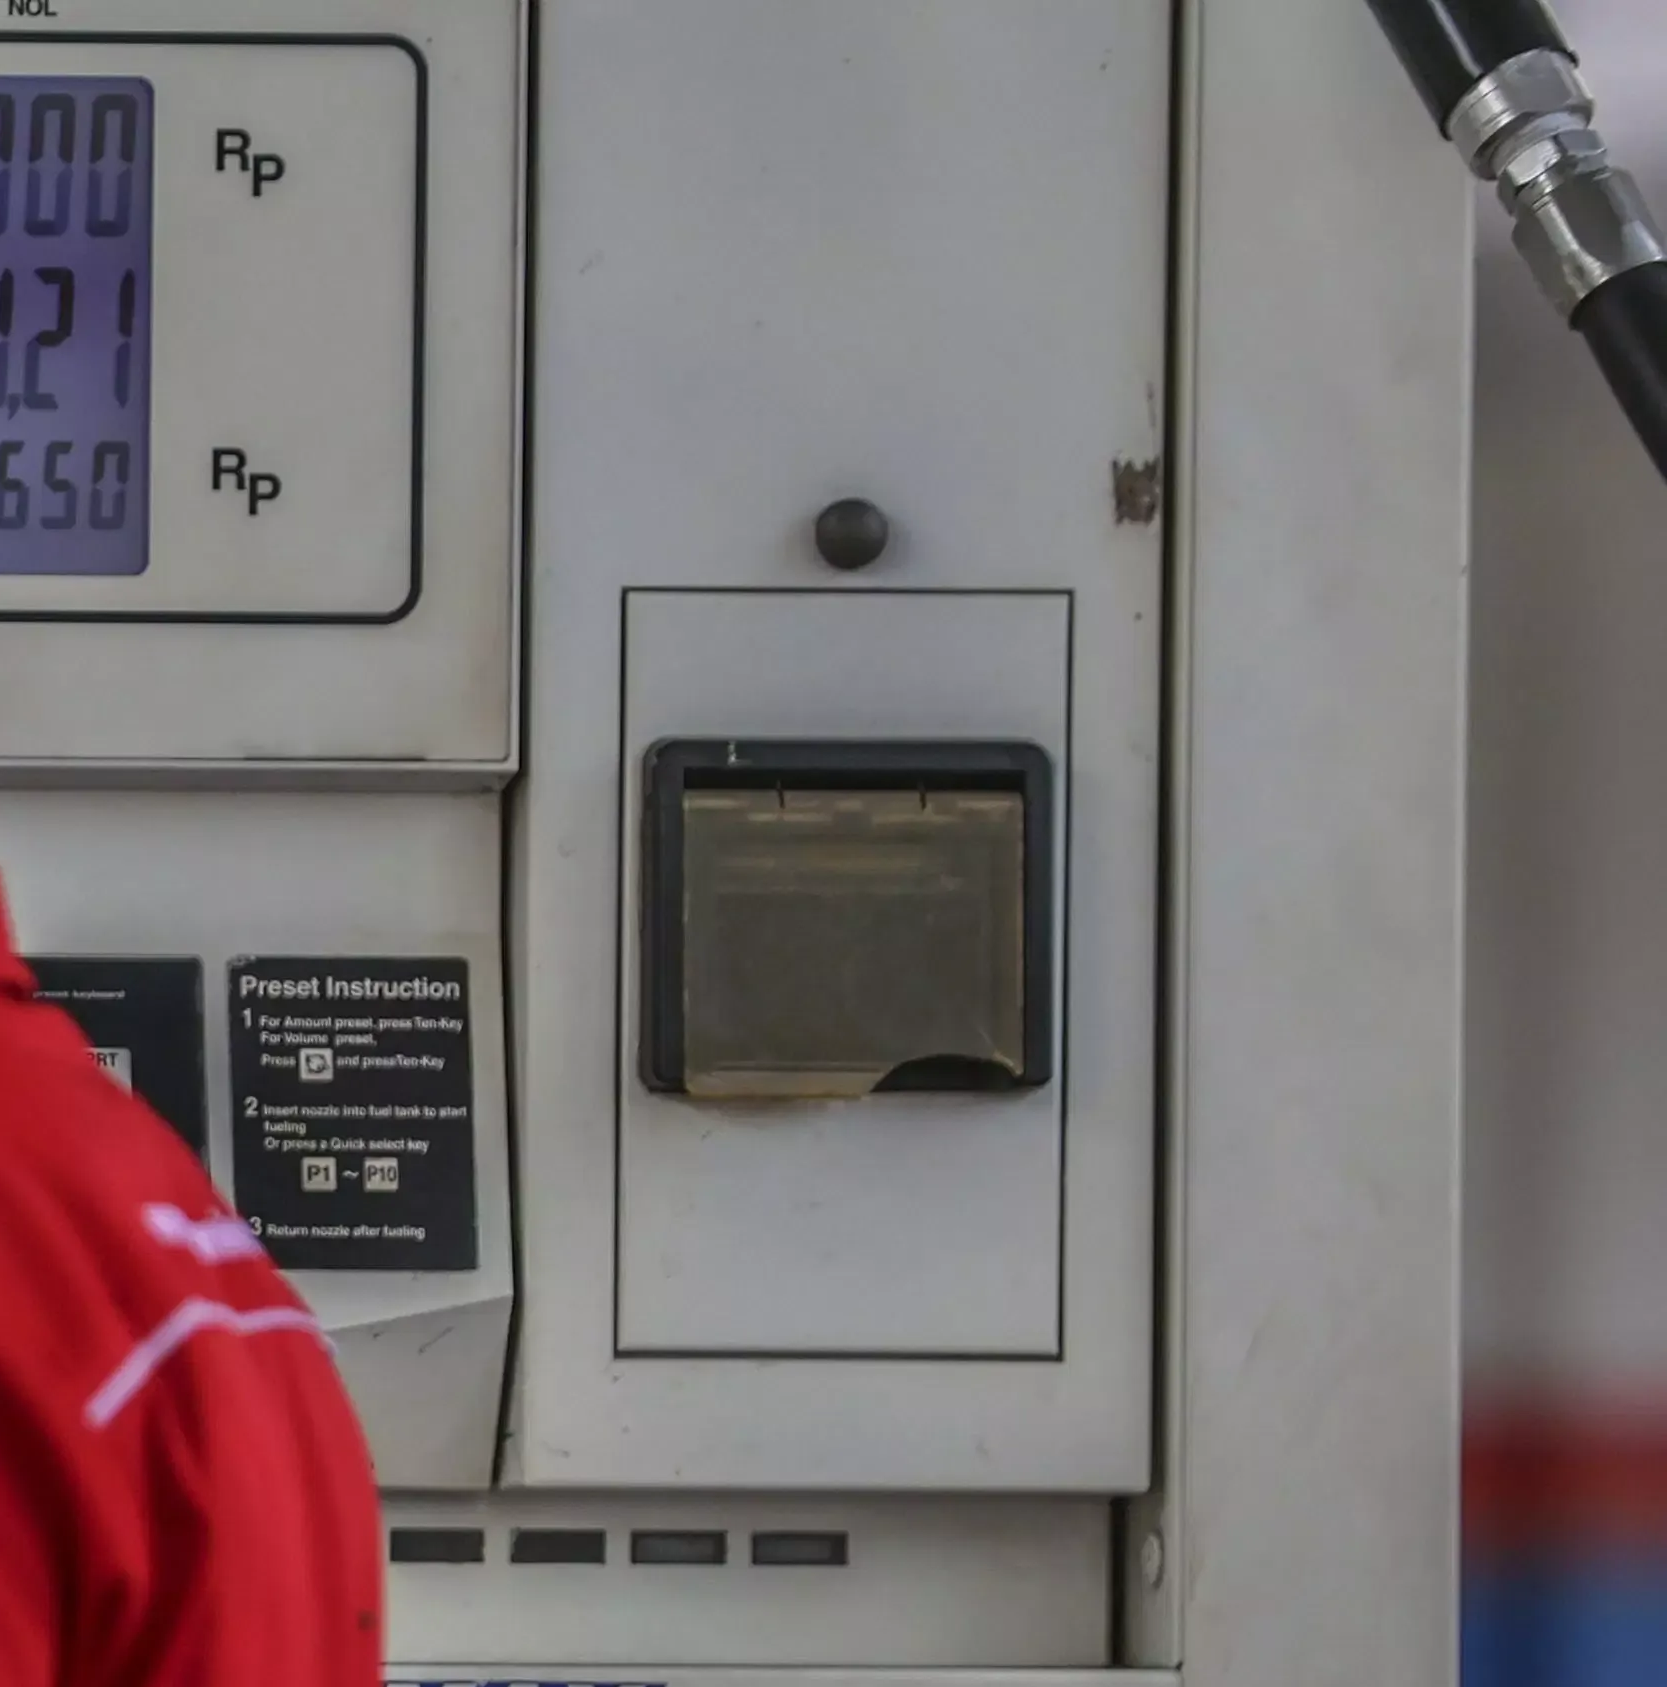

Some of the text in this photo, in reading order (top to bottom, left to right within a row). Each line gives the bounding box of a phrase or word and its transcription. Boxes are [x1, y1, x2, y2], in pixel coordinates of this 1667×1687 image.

[8, 0, 57, 16] NOL
[240, 976, 460, 998] Preset Instruction
[243, 1008, 251, 1027] 1
[245, 1097, 258, 1116] 2
[307, 1165, 397, 1182] P1 P10
[251, 1217, 262, 1235] 3
